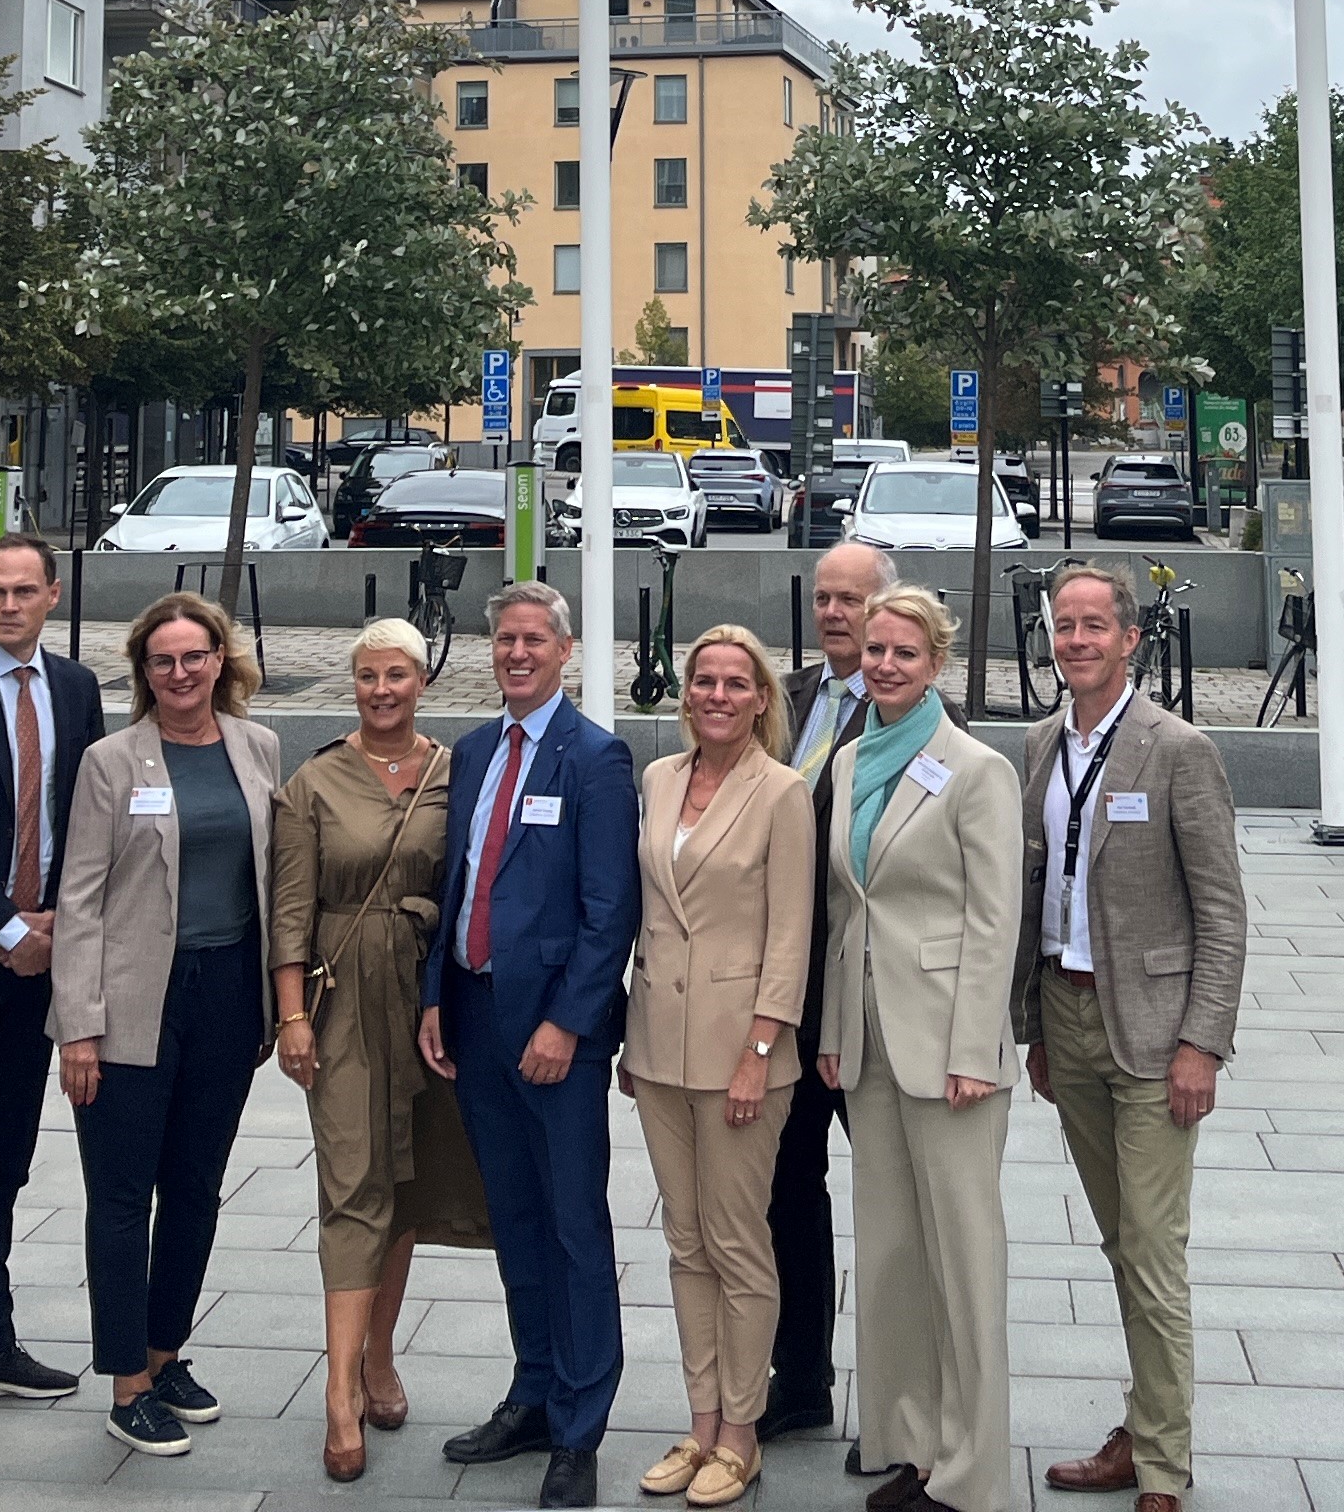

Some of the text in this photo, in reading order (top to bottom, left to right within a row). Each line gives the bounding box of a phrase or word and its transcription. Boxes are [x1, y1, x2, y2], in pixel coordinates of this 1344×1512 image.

[489, 353, 504, 375] P
[706, 369, 718, 385] P
[958, 374, 973, 396] P
[1168, 388, 1181, 405] P
[518, 473, 529, 511] seom
